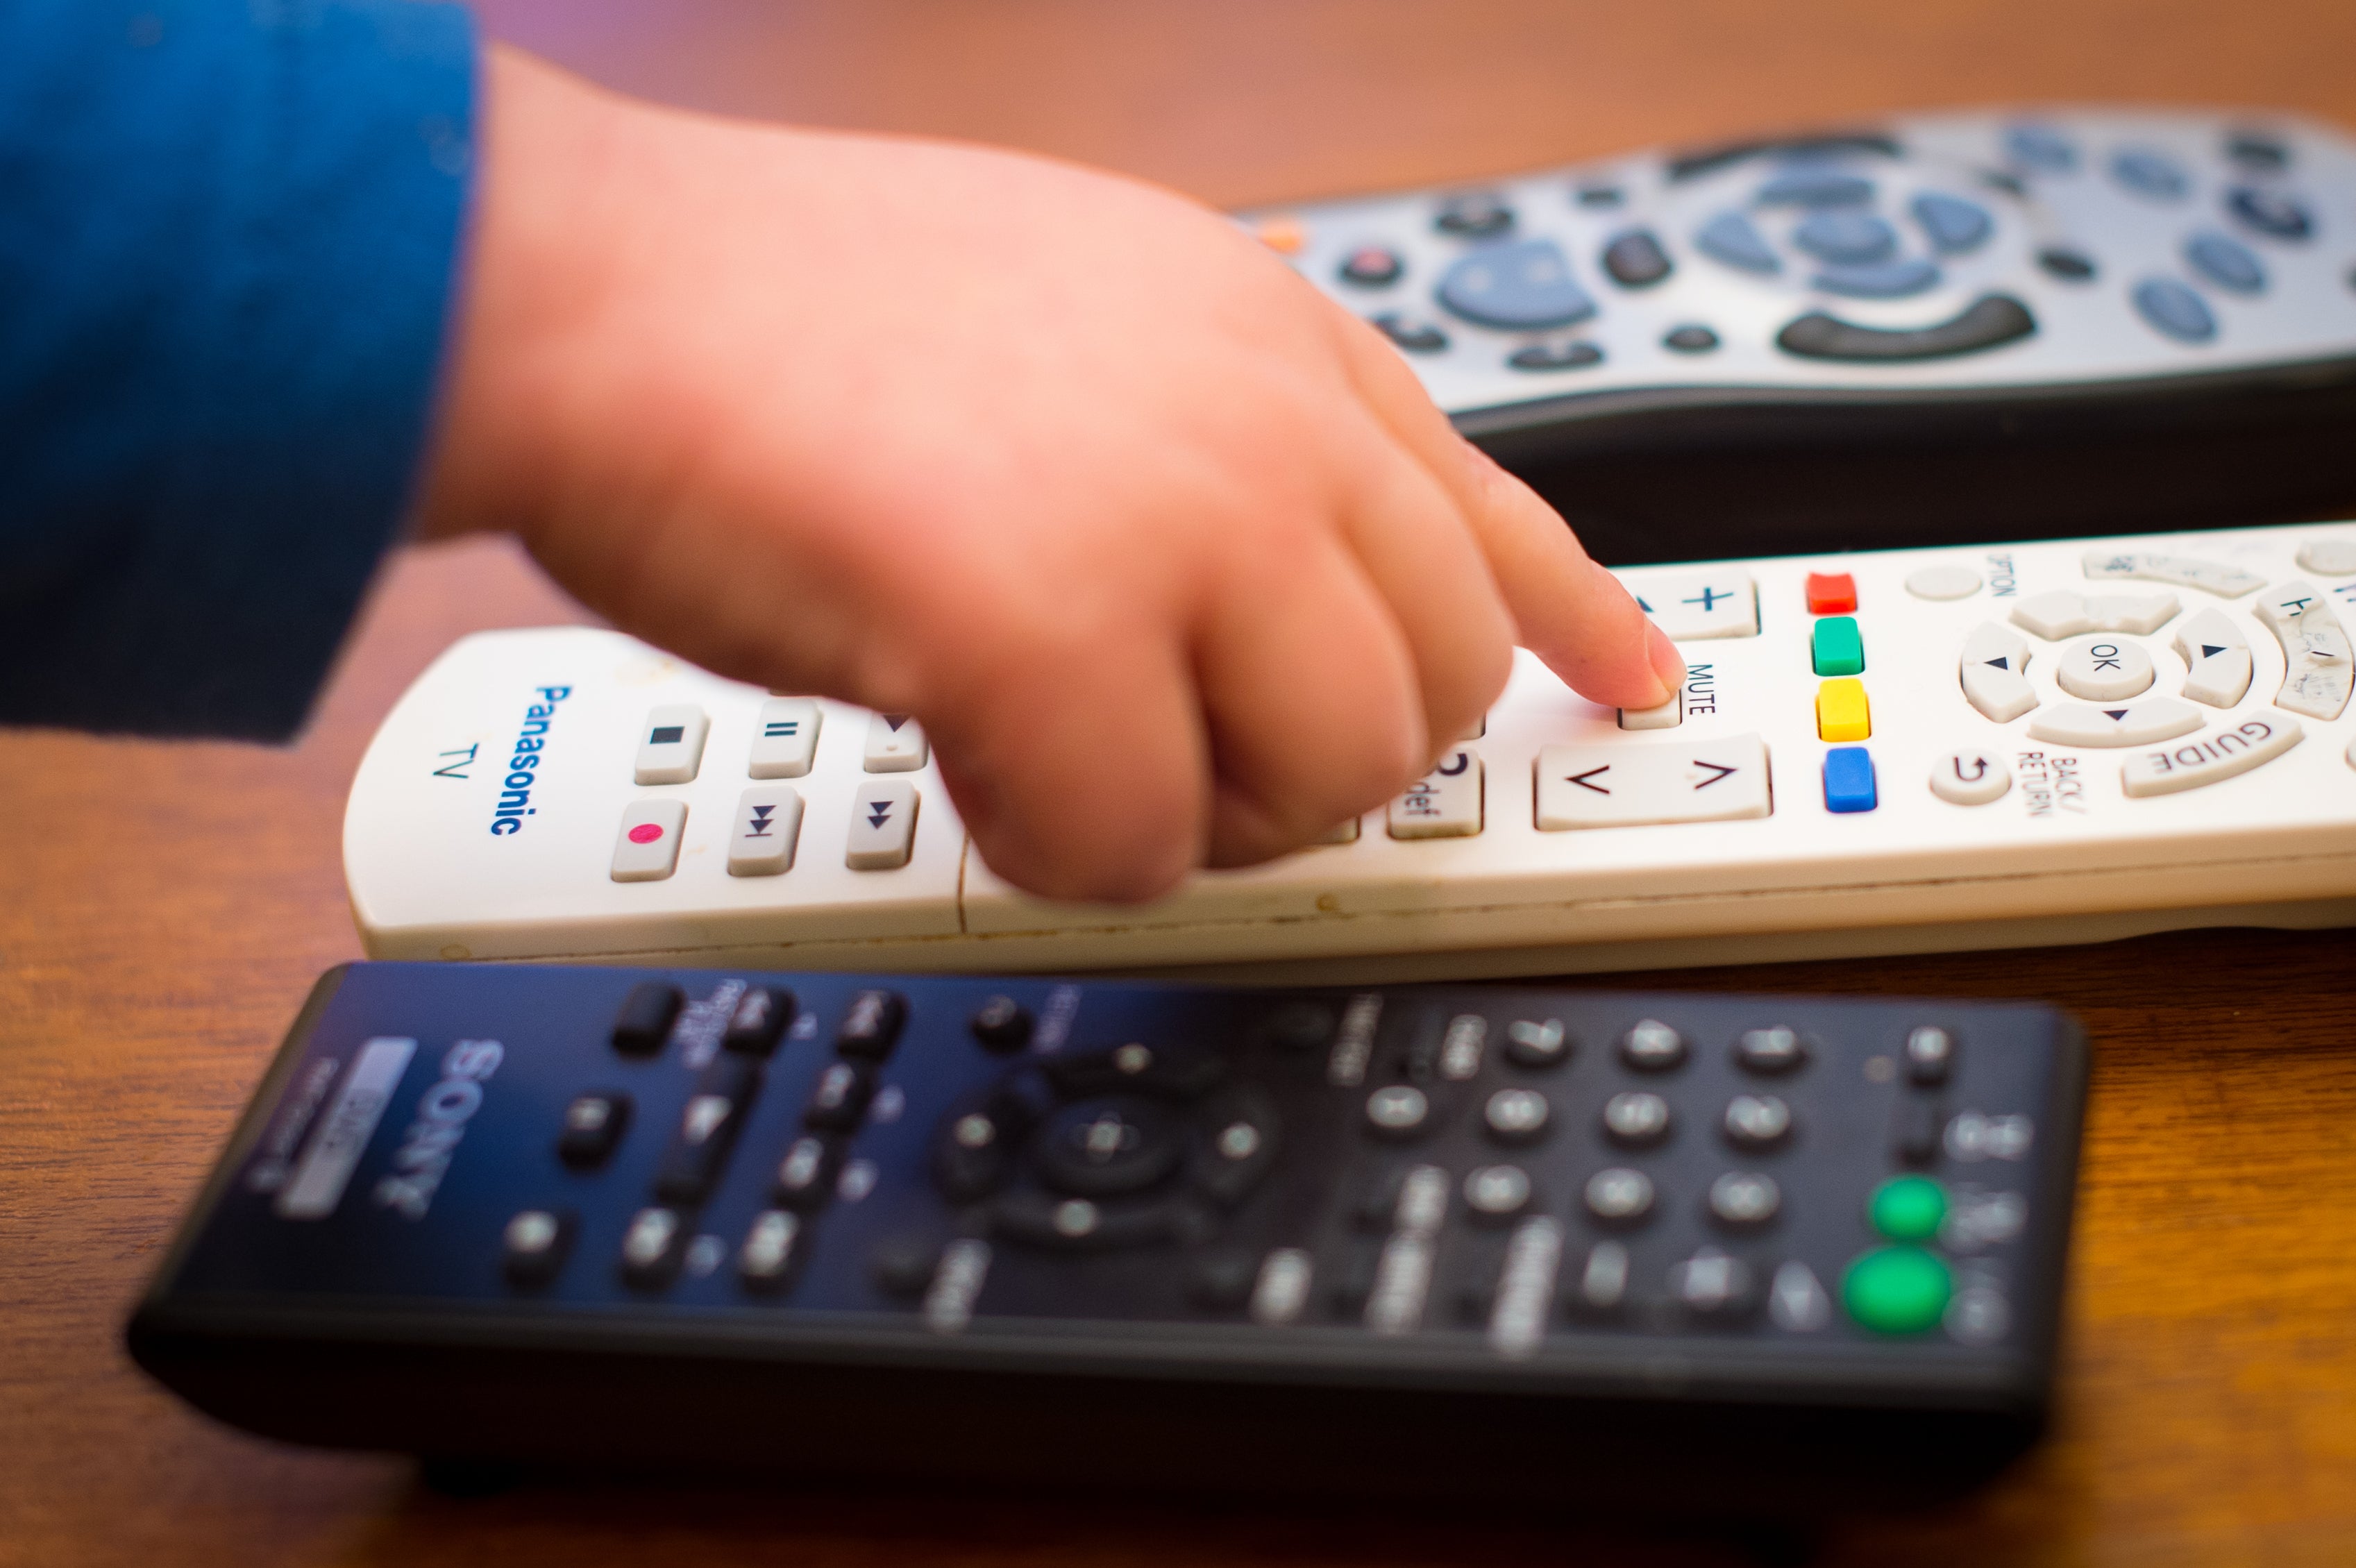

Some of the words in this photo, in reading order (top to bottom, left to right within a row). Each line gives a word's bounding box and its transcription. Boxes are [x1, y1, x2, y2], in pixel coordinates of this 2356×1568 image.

[2090, 644, 2121, 671] OK
[1688, 664, 1715, 715] MUTE
[433, 742, 479, 778] TV
[490, 685, 572, 835] Panasonic
[2147, 722, 2271, 773] GUIDE
[2017, 752, 2053, 817] RETURN
[371, 1038, 505, 1224] SONY
